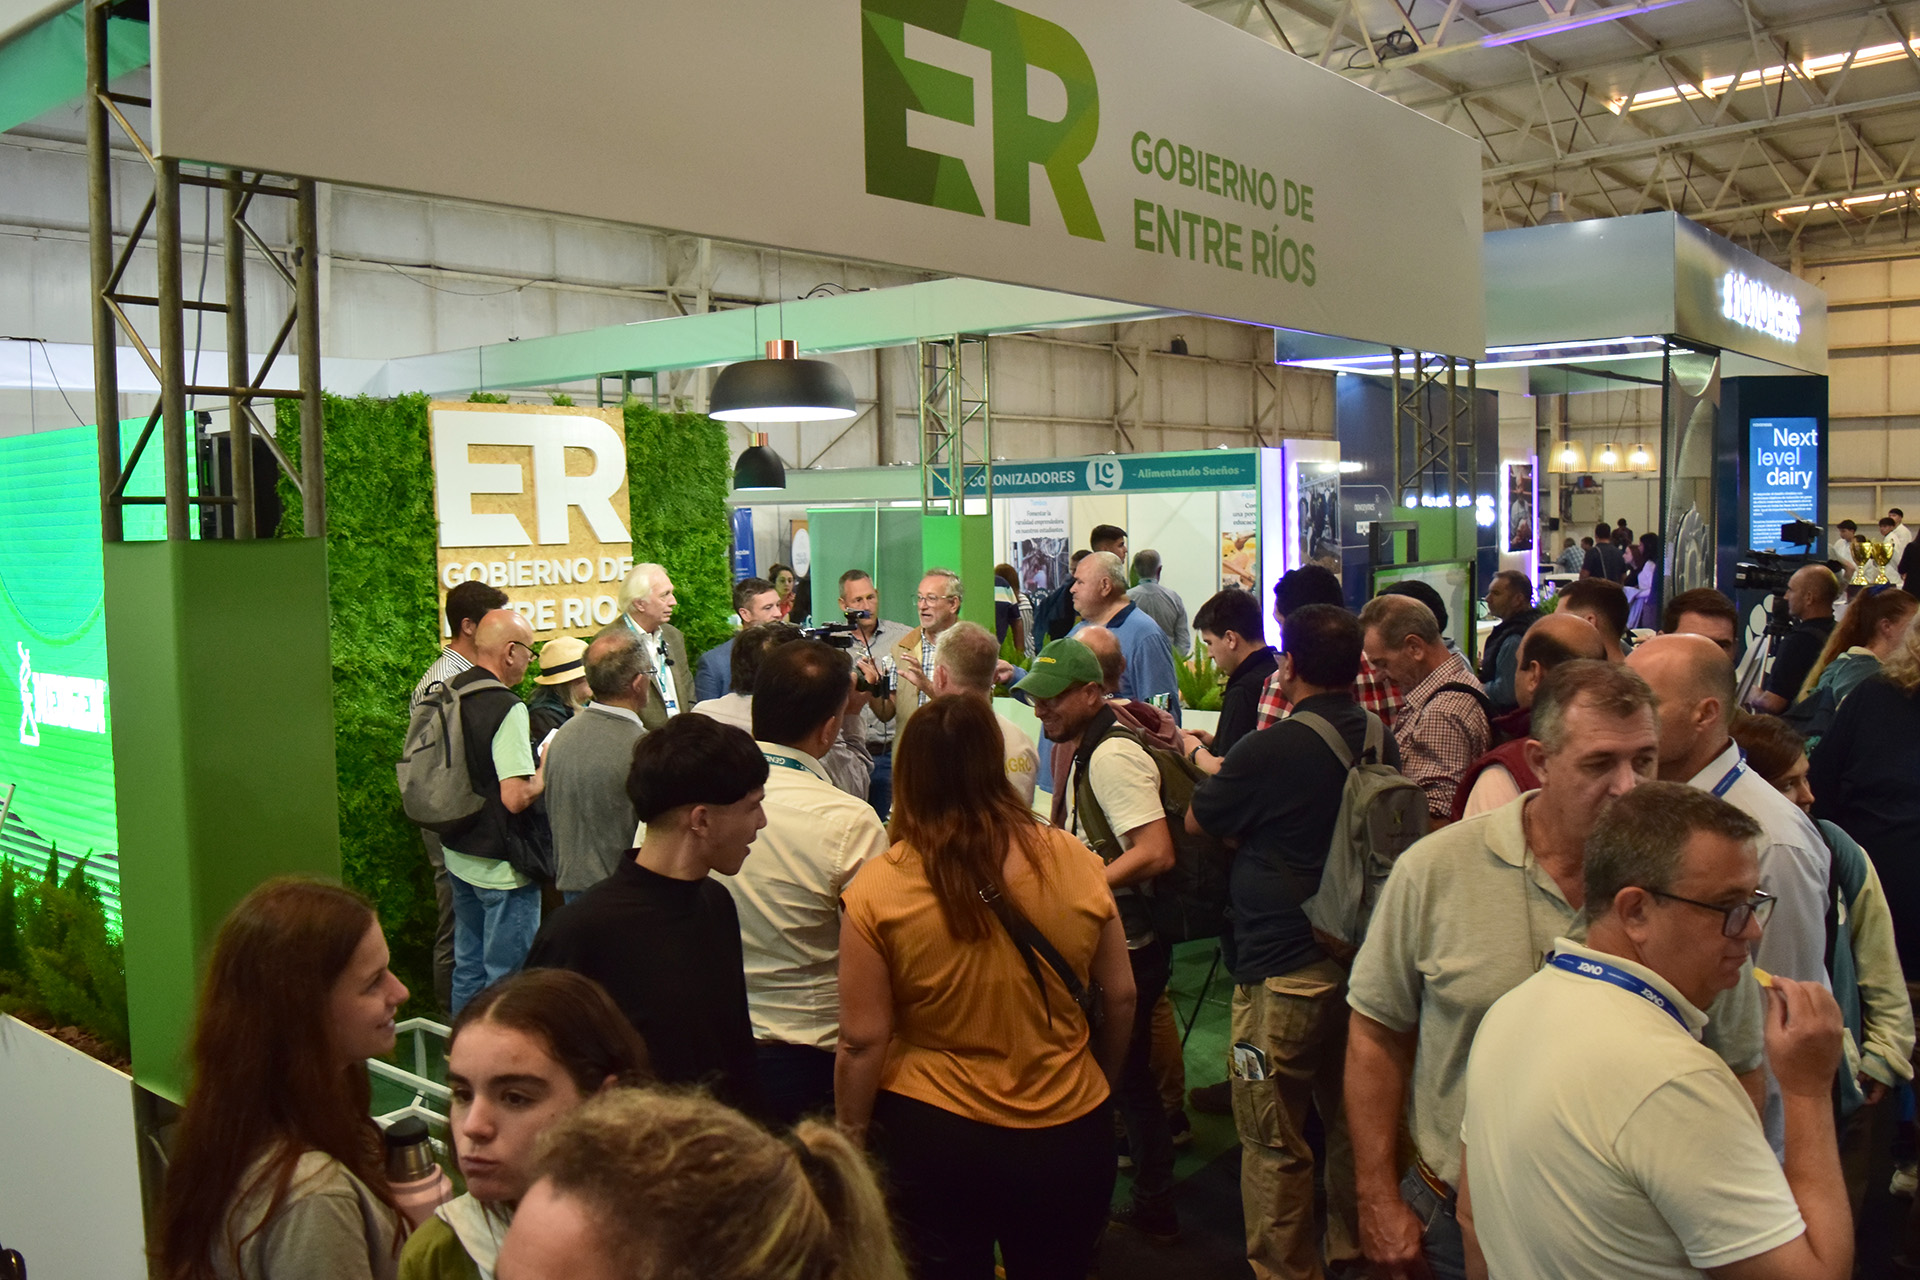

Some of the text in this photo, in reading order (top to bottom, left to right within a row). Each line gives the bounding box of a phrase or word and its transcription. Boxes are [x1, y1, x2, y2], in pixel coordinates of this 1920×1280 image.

[861, 0, 1106, 242] ER
[1131, 130, 1314, 223] GOBIERNO DE
[1134, 198, 1316, 287] ENTRE RÍOS
[1773, 428, 1818, 447] Next
[1757, 447, 1800, 466] level
[432, 410, 633, 548] ER
[968, 471, 1075, 488] COONIZADORES
[1202, 465, 1239, 476] Sueños
[1766, 467, 1812, 489] dairy
[563, 595, 618, 628] RIO
